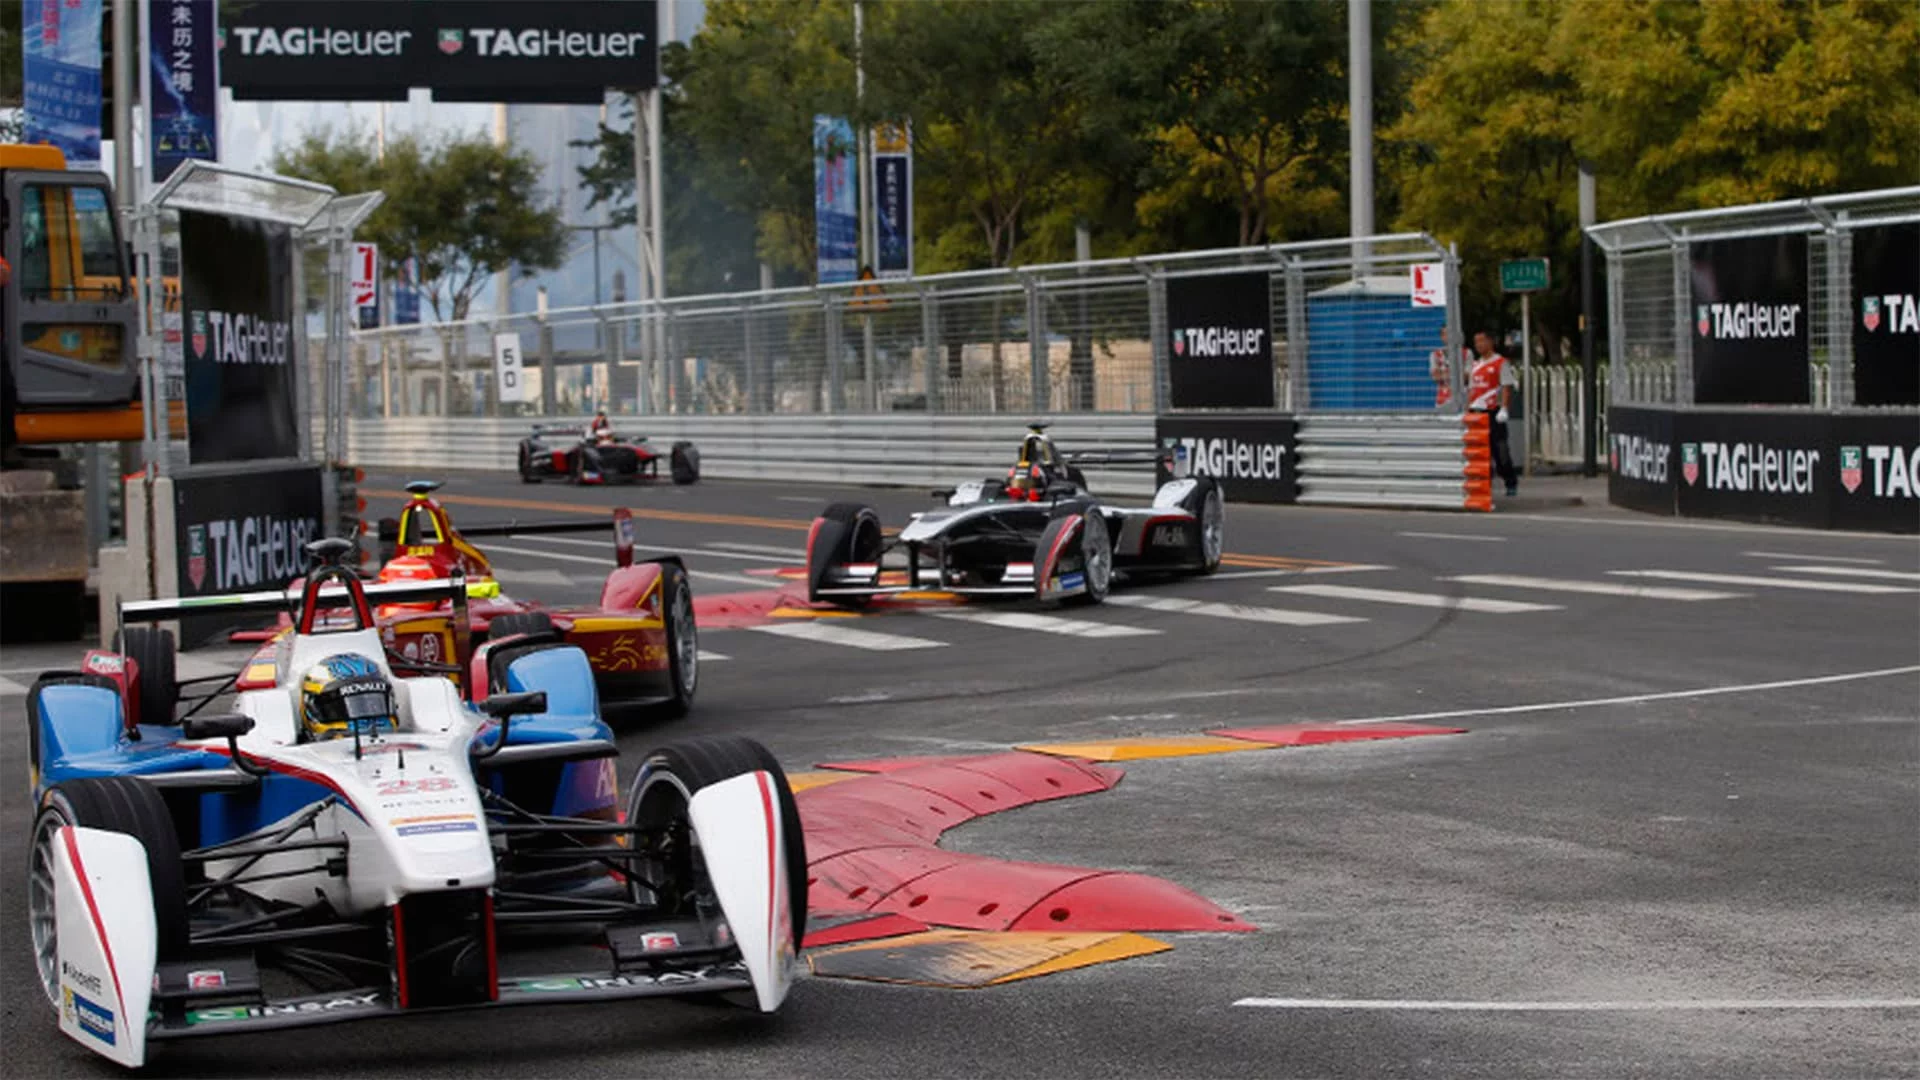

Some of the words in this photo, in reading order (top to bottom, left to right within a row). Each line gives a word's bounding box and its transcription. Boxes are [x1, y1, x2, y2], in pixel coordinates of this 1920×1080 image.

[171, 0, 194, 92] 未历之境
[234, 28, 411, 55] TAGHeuer
[470, 29, 645, 56] TAGHeuer
[1711, 303, 1800, 339] TAGHeuer
[1884, 294, 1920, 333] TA
[208, 310, 289, 364] TAGHeuer
[1186, 327, 1264, 357] TAGHeuer
[1181, 438, 1286, 479] TAGHeuer
[1618, 433, 1670, 483] TAGHeuer
[1702, 443, 1820, 493] TAGHeuer
